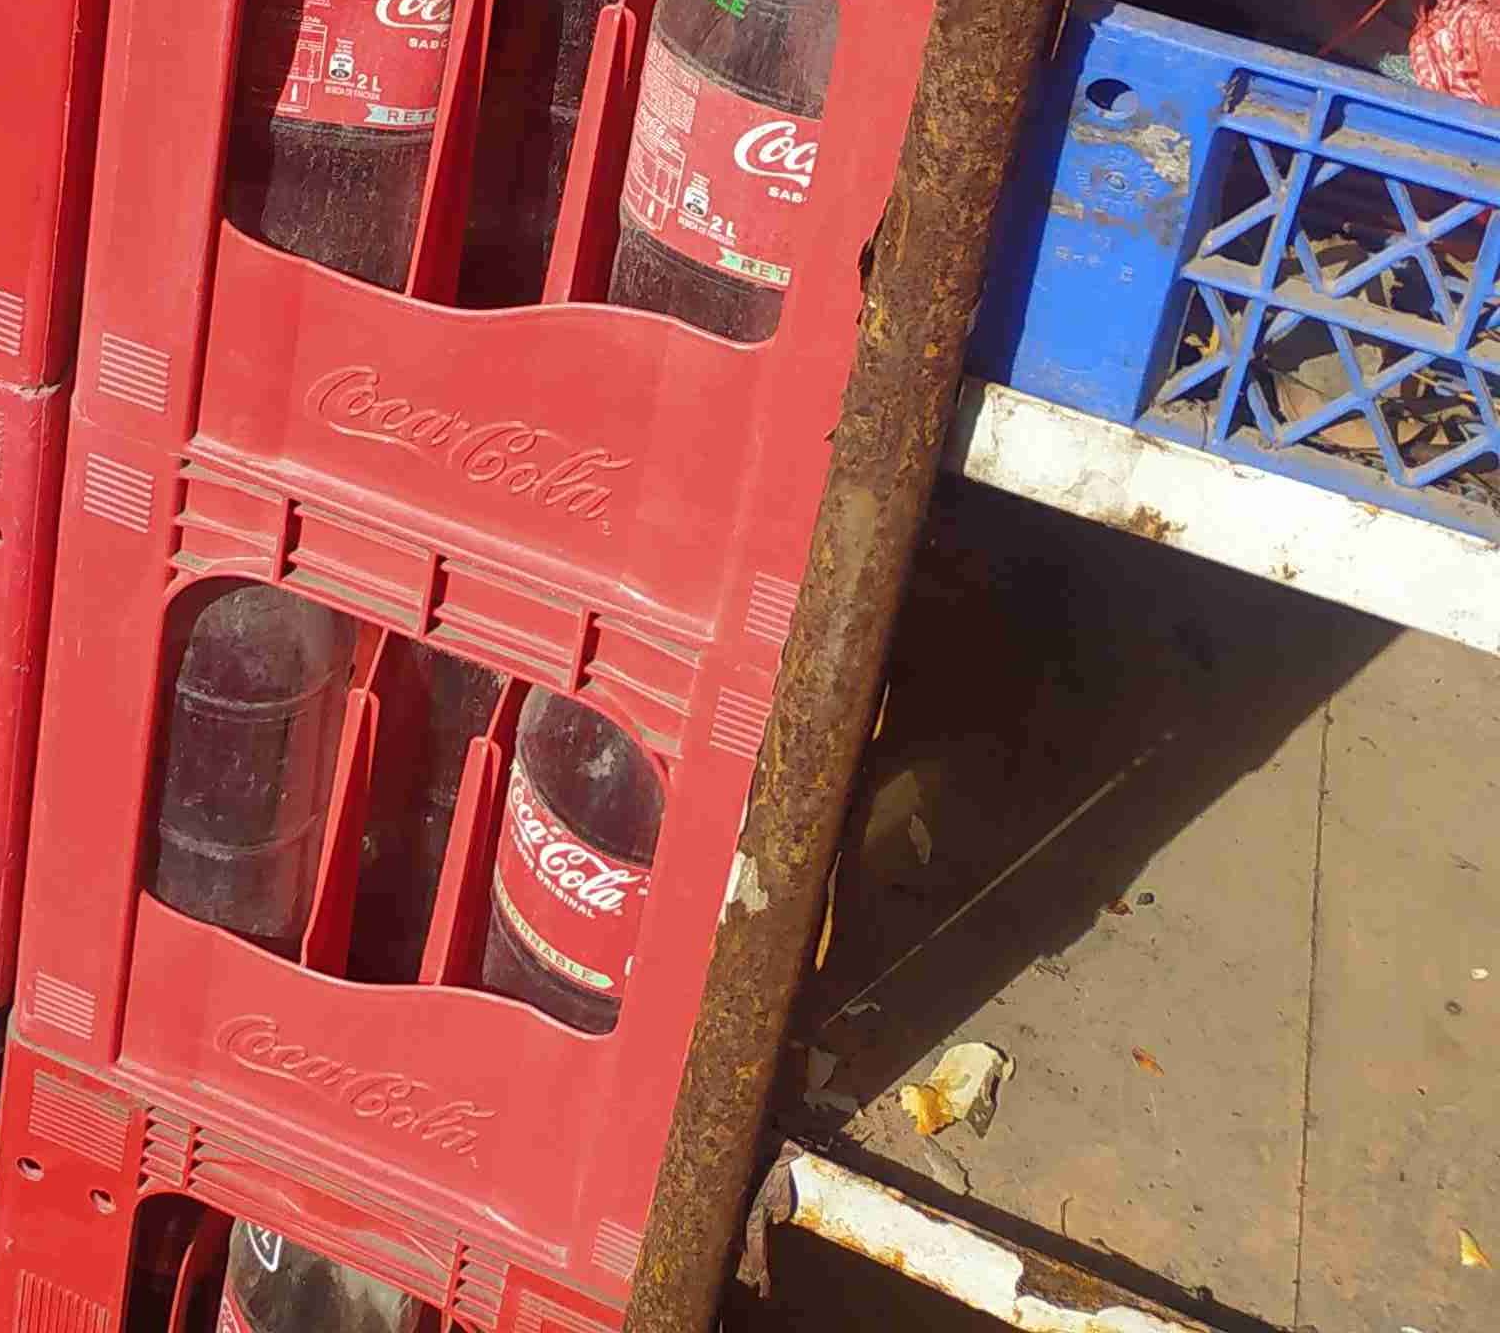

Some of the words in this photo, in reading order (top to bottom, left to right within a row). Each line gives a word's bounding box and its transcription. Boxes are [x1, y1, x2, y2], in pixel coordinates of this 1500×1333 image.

[356, 73, 368, 90] 2
[372, 75, 383, 92] L
[710, 214, 724, 232] 2
[726, 220, 738, 238] L
[303, 365, 635, 521] Coca-Cola
[509, 757, 644, 911] Coca-Cola
[535, 868, 597, 919] ORIGINAL
[213, 1013, 498, 1155] Coca-Cola
